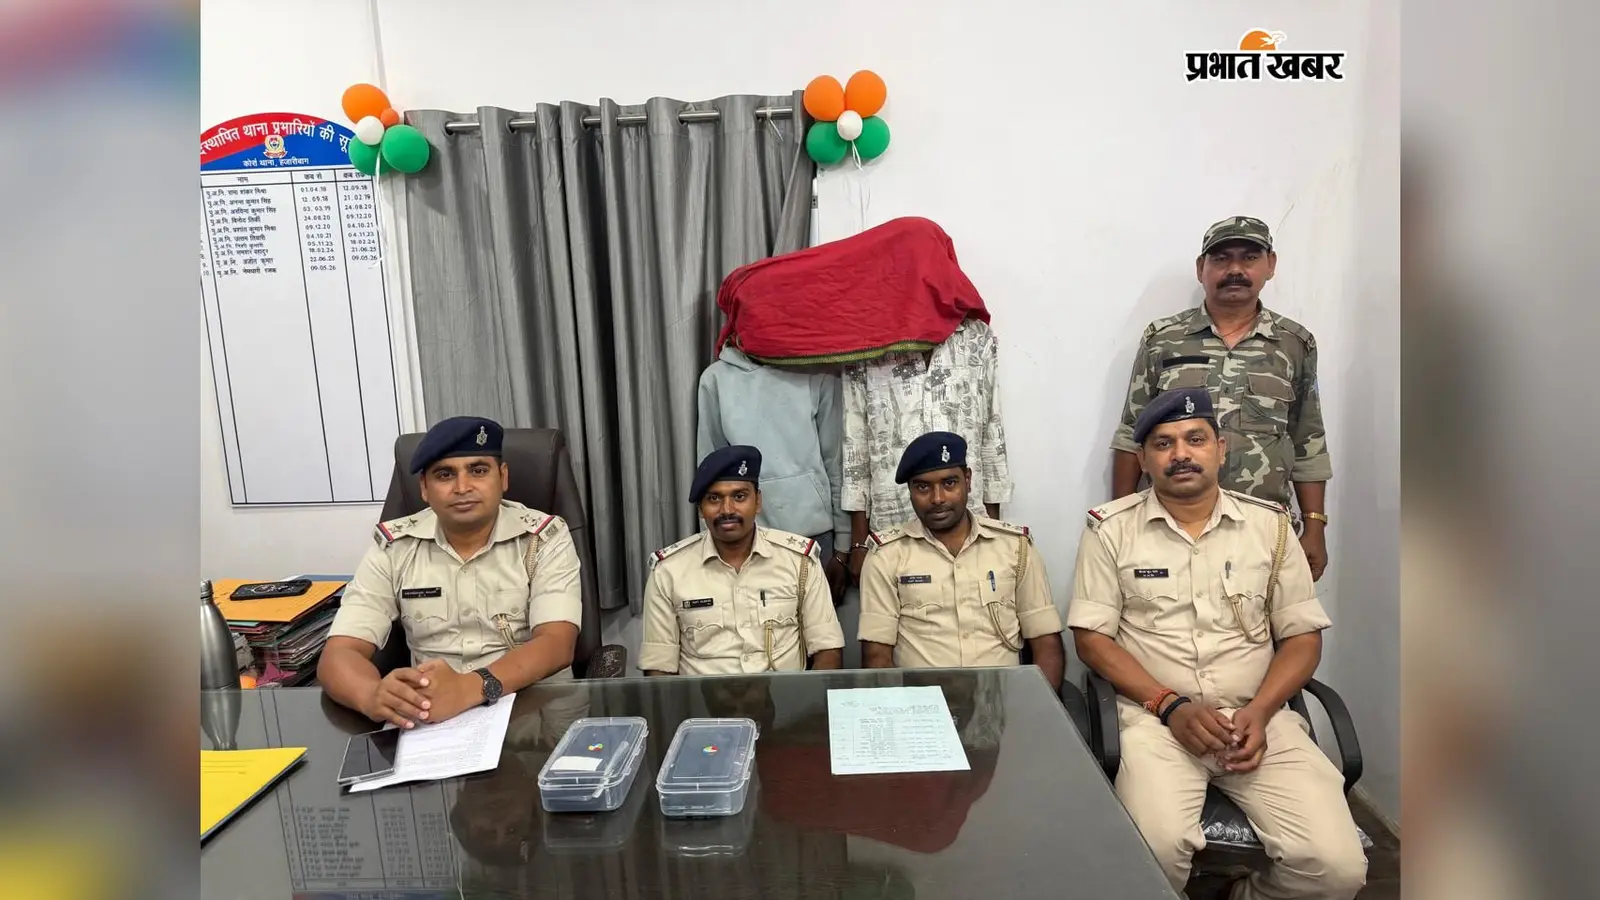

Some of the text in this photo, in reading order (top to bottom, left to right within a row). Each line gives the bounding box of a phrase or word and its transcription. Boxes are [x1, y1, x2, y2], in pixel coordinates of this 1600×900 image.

[243, 122, 269, 138] थाना
[272, 118, 316, 138] प्रभारियों
[319, 124, 335, 143] की
[339, 134, 351, 153] सू
